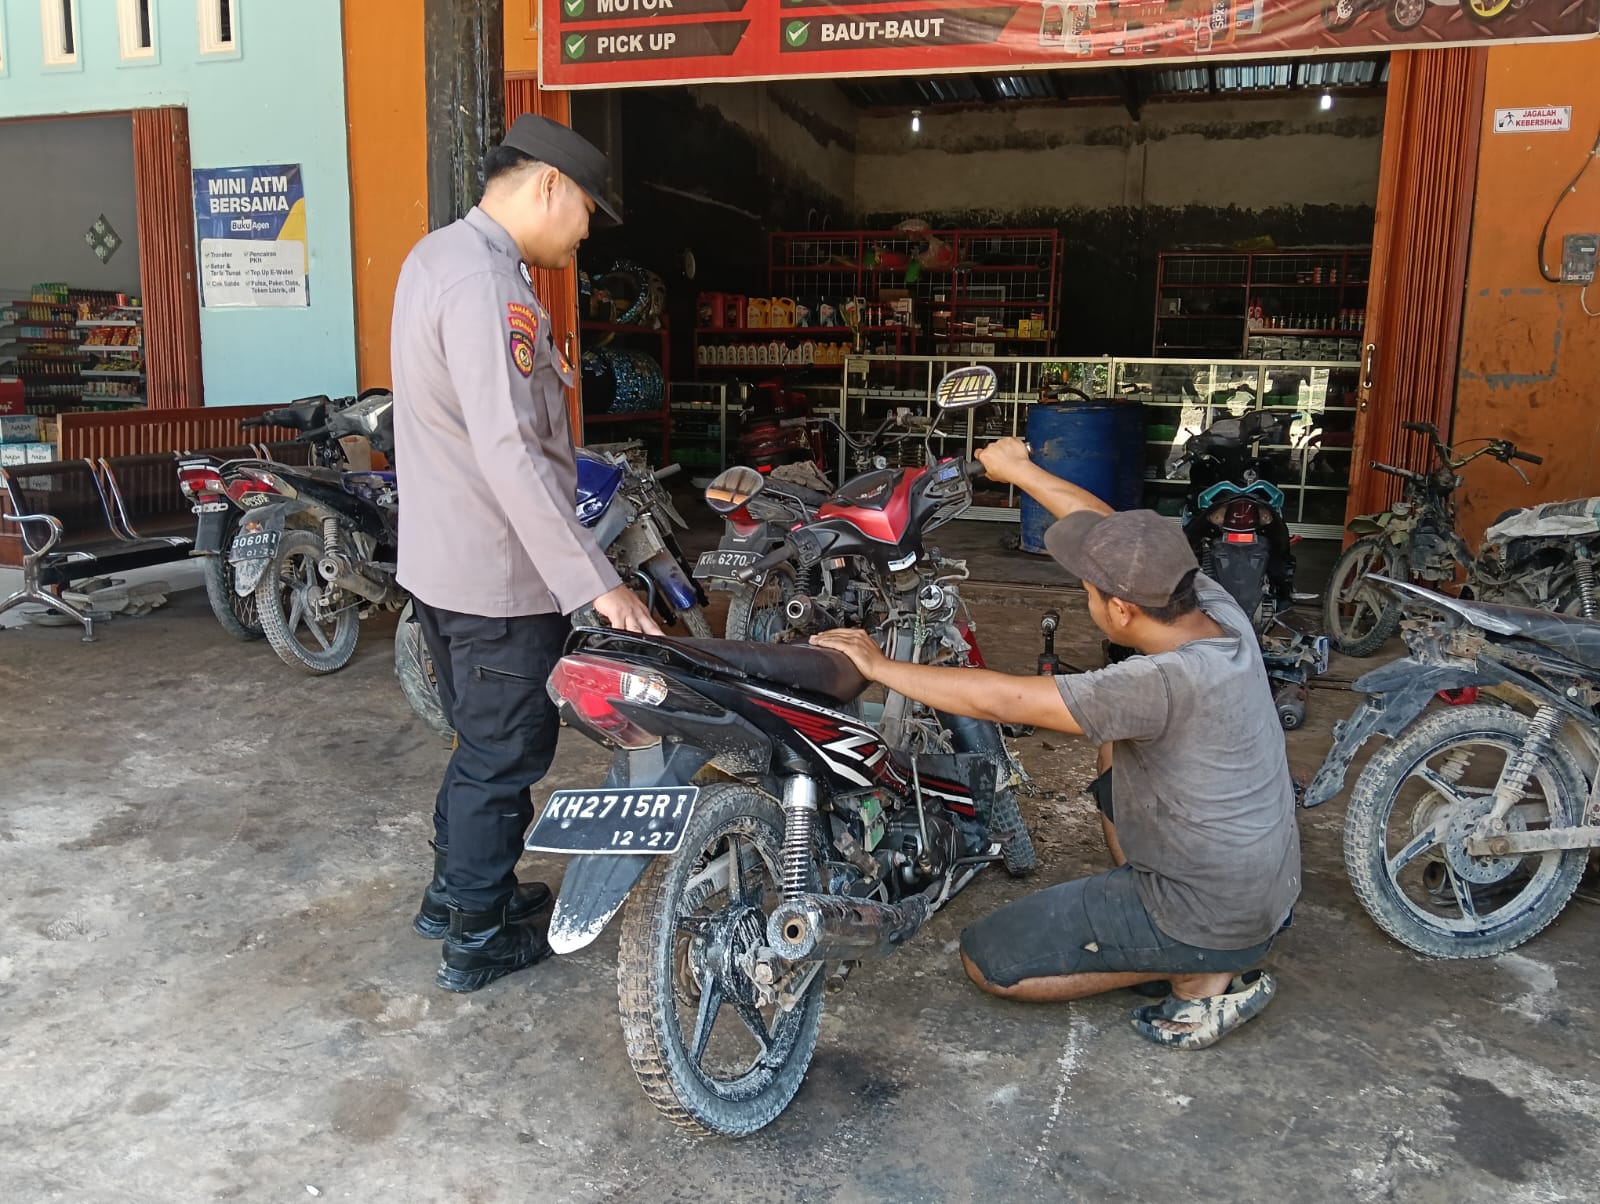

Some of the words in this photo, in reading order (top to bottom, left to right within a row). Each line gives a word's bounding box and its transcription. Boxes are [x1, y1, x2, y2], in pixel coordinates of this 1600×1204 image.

[821, 17, 945, 42] BAUT-BAUT
[597, 34, 644, 54] PICK
[649, 32, 677, 51] UP
[1522, 109, 1557, 118] JAGALAH
[1515, 118, 1563, 127] KEBERSIHAN
[208, 178, 245, 195] MINI
[250, 175, 288, 194] ATM
[210, 196, 289, 213] BERSAMA
[718, 553, 748, 567] 6270
